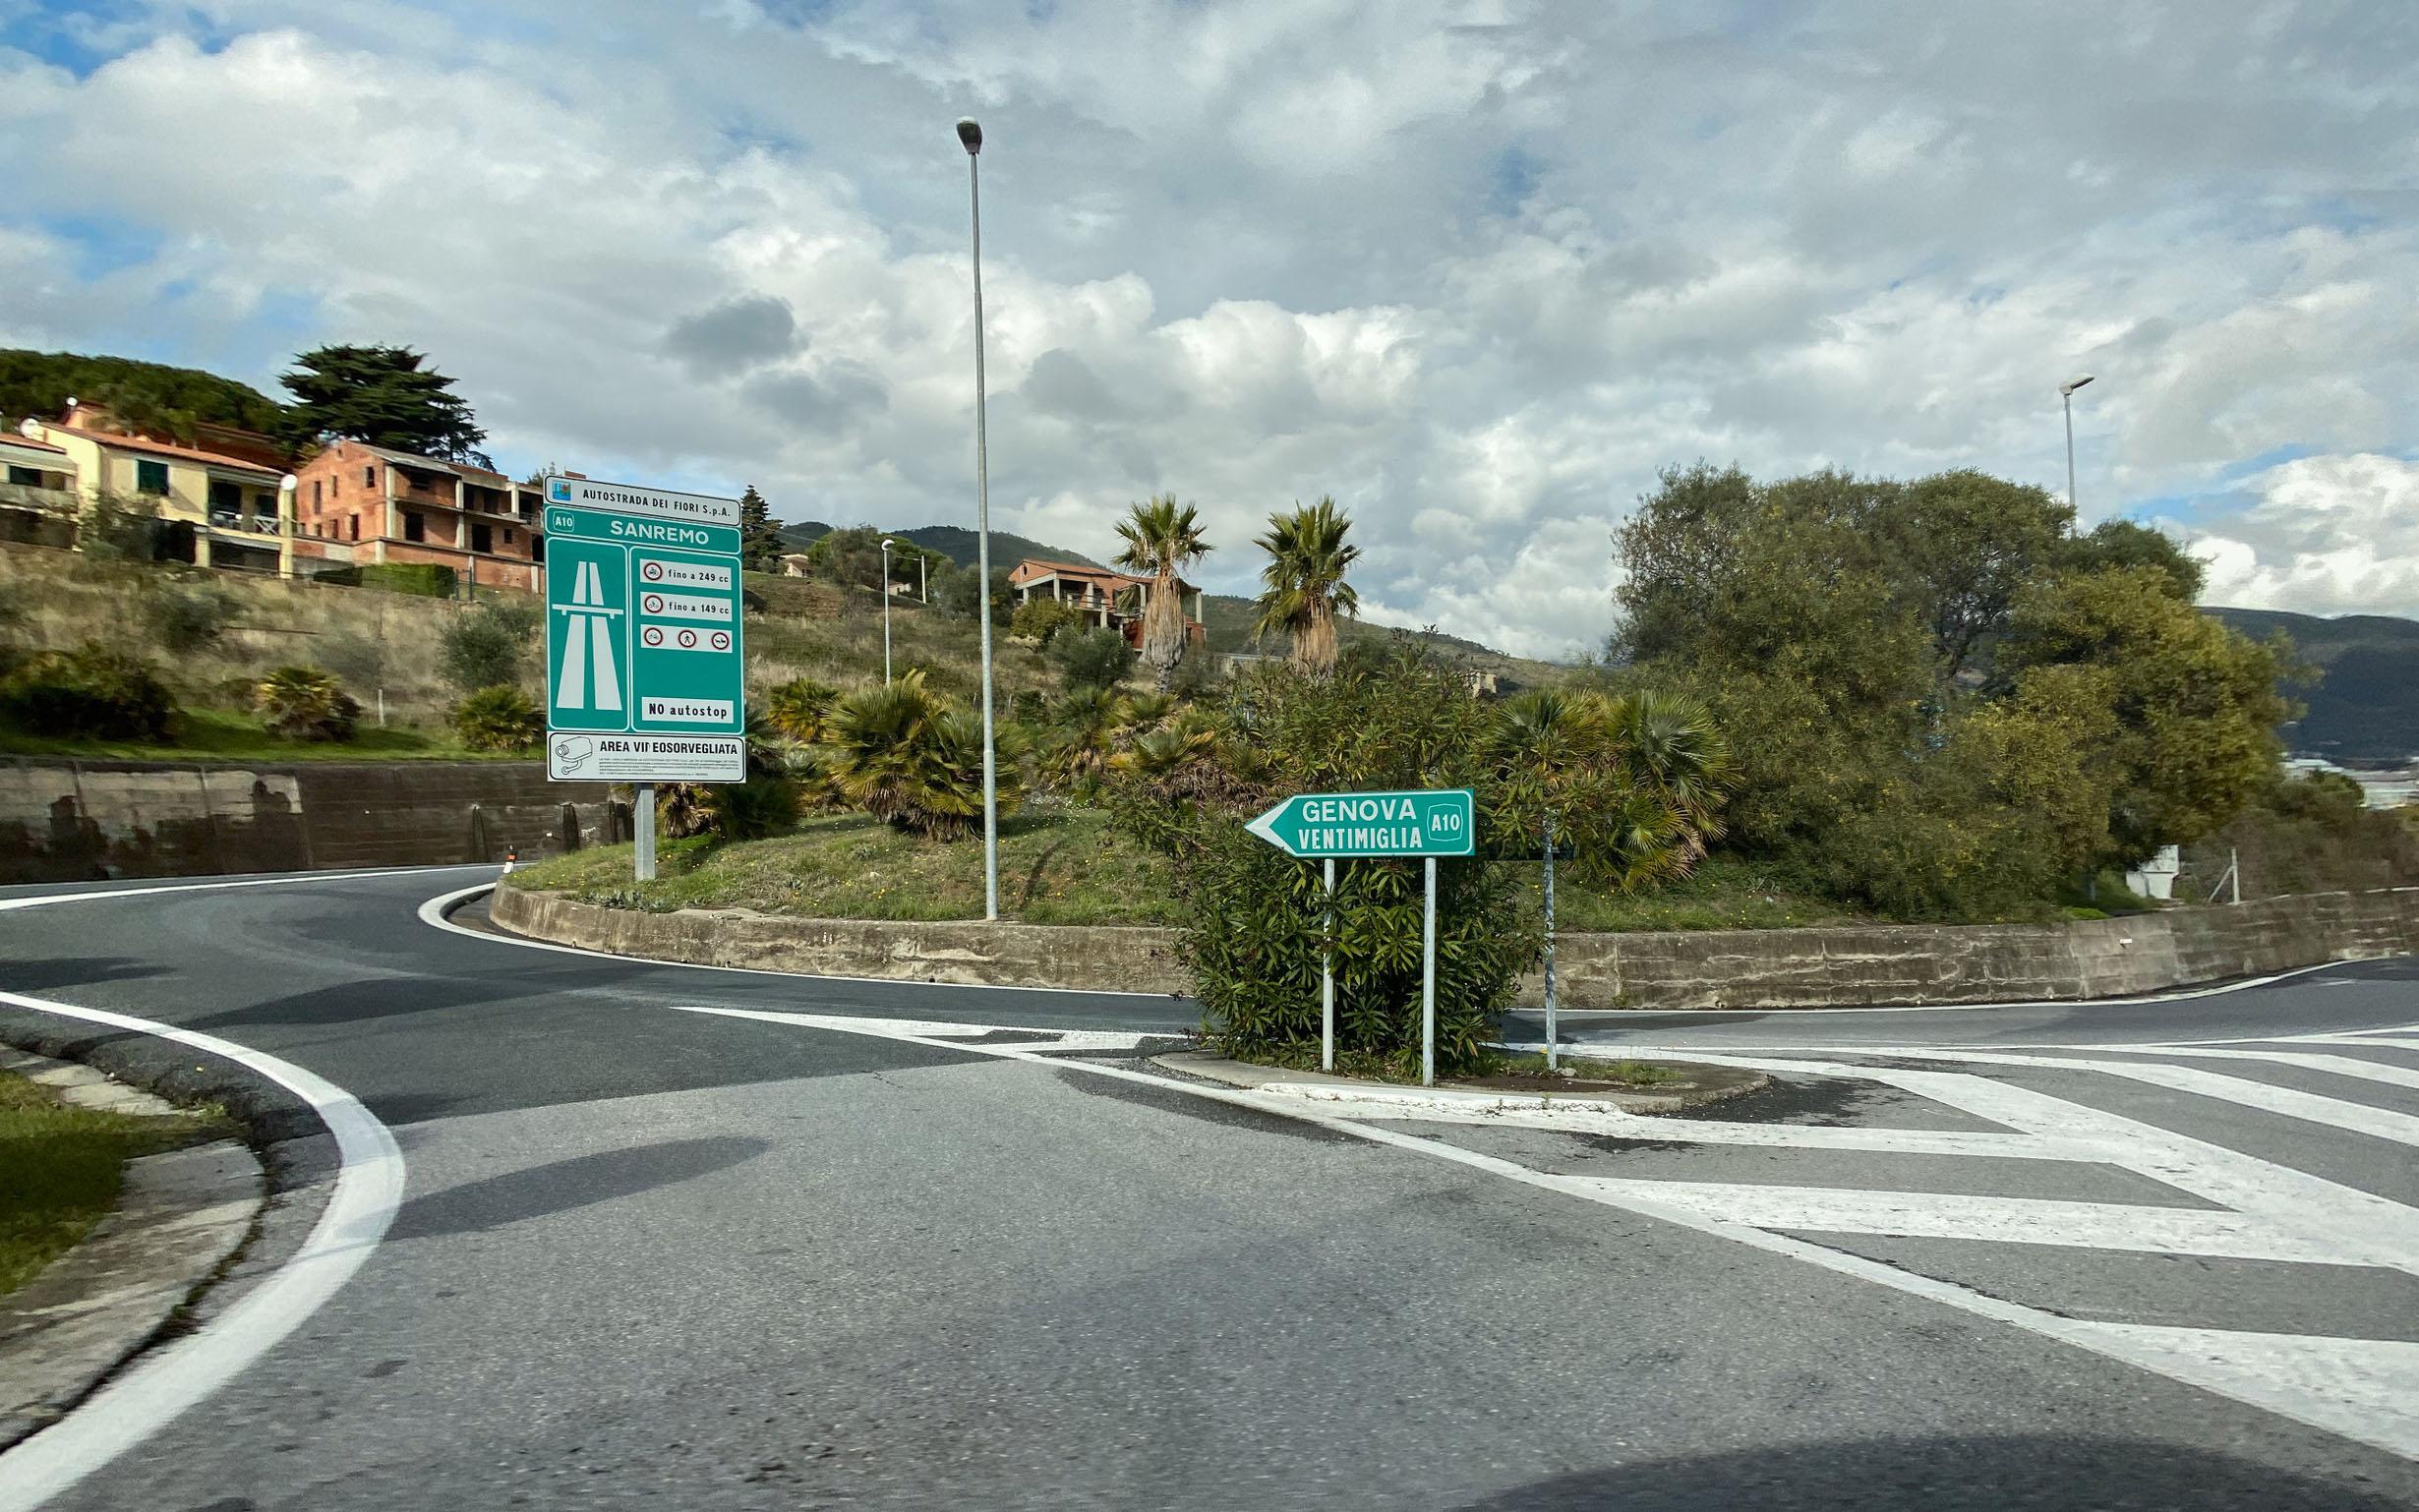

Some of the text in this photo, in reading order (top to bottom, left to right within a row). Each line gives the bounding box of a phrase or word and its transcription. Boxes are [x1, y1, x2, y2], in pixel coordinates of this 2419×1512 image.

[582, 489, 649, 506] AUTOSTRADA
[652, 497, 669, 509] DEI
[674, 500, 699, 512] FIORI
[555, 516, 574, 528] A10
[610, 520, 709, 545] SANREMO
[668, 569, 687, 579] fino
[699, 572, 717, 582] 249
[669, 602, 688, 611] fino
[701, 604, 717, 613] 149
[649, 703, 728, 720] NO autostop
[600, 740, 630, 753] AREA
[1302, 798, 1417, 823] GENOVA
[1431, 814, 1460, 832] A10
[1298, 827, 1423, 850] VENTIMIGLIA
